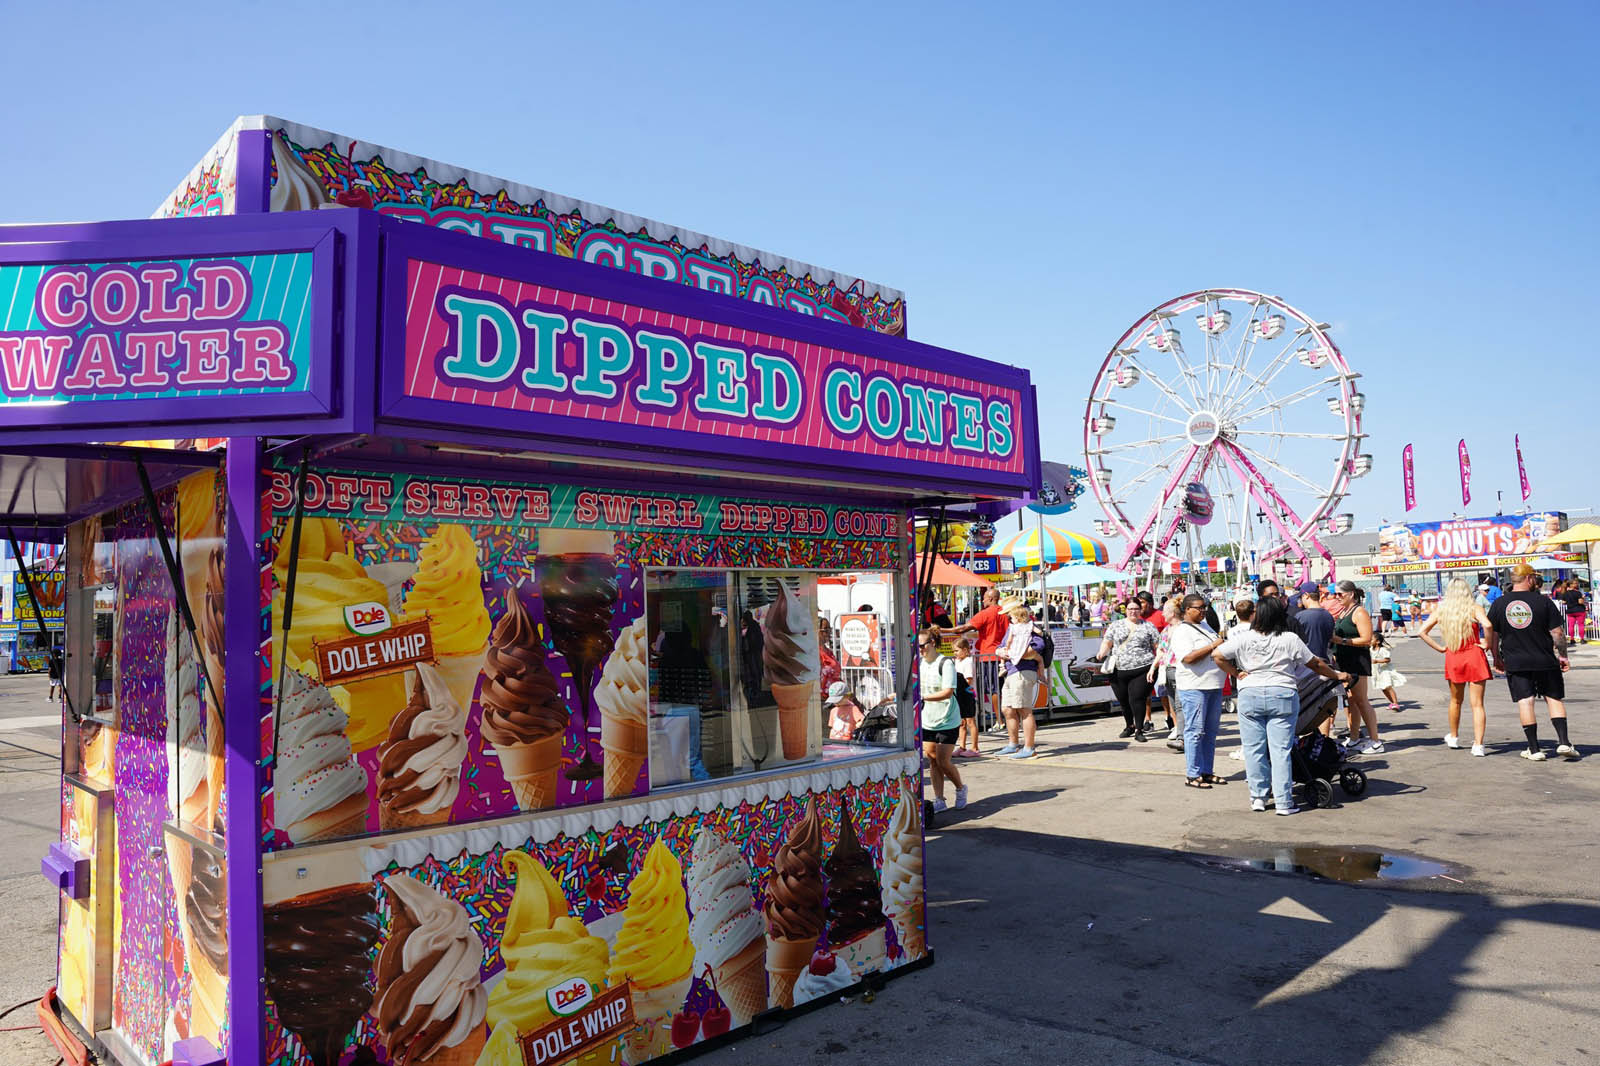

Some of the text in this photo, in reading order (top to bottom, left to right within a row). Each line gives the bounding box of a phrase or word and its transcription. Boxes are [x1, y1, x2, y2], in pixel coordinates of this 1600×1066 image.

[41, 266, 248, 328] COLD
[0, 327, 292, 391] WATER
[443, 294, 1014, 457] DIPPED CONES
[271, 471, 550, 521] SOFT SERVE
[576, 492, 703, 528] SWIRL
[719, 503, 828, 534] DIPPED
[1422, 526, 1514, 557] DONUTS
[1405, 562, 1430, 571] DONUTS
[1460, 559, 1488, 567] PRETZELS
[352, 607, 385, 625] Dole
[327, 633, 426, 675] DOLE WHIP
[555, 983, 586, 1006] Dole
[532, 997, 627, 1066] DOLE WHIP
